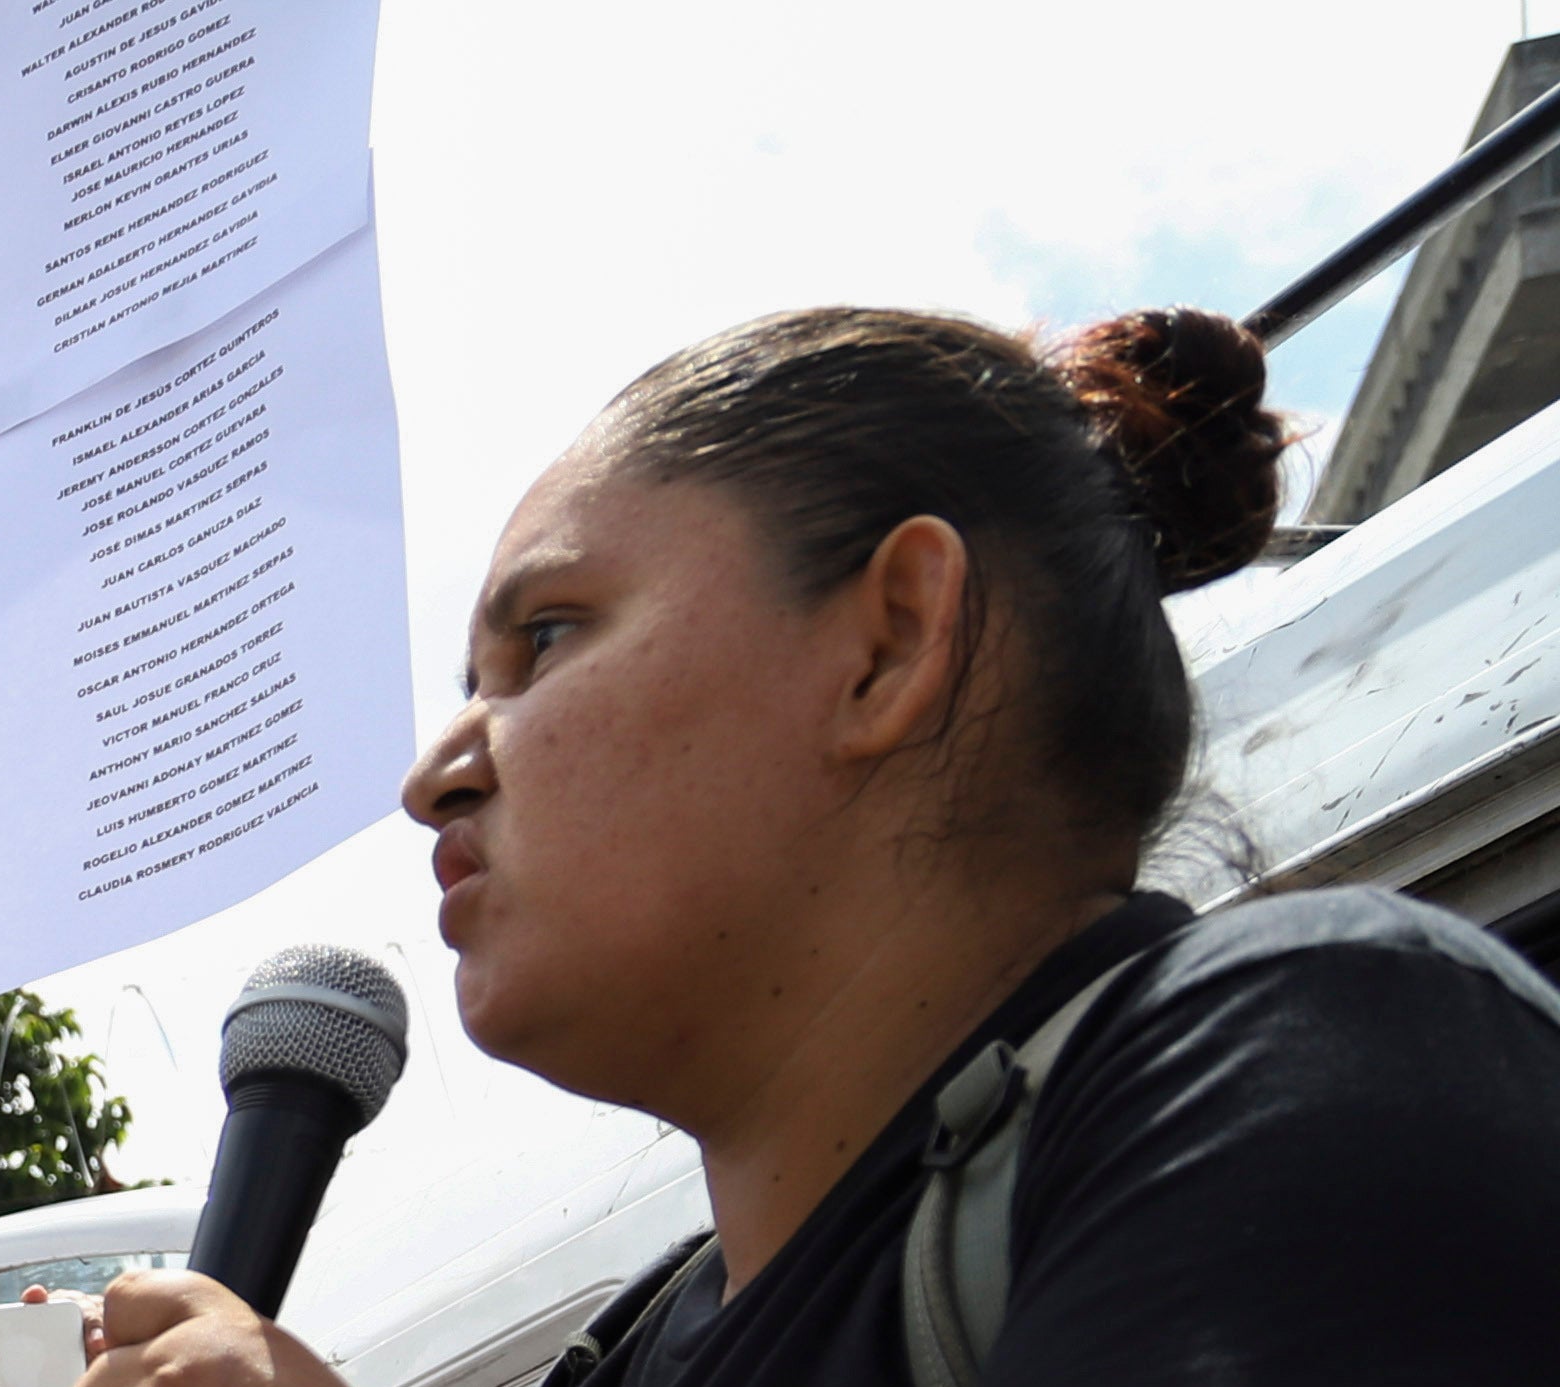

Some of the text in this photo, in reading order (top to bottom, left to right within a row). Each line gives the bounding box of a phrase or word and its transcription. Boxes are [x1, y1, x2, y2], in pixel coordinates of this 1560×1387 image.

[47, 28, 256, 141] DARWIN ALEXIS RUBIO HERNANDEZ
[51, 56, 255, 166] ELMER GIOVANNI CASTRO GUERRA
[67, 14, 230, 104] CRISANTO RODRIGO GOMEZ
[71, 110, 238, 202] JOSE MAURICIO HERNANDEZ
[73, 350, 265, 466] ISMAEL ALEXANDER ARIAS GARCIA
[101, 497, 262, 589] JUAN CARLOS GANUZA DIAZ
[77, 582, 295, 698] OSCAR ANTONIO HERNANDEZ ORTEGA
[89, 673, 296, 781] ANTHONY MARIO SANCHEZ SALINAS
[102, 651, 281, 747] VICTOR MANUEL FRANCO CRUZ
[78, 782, 319, 901] CLAUDIA ROSMERY RODRIGUEZ VALENCIA
